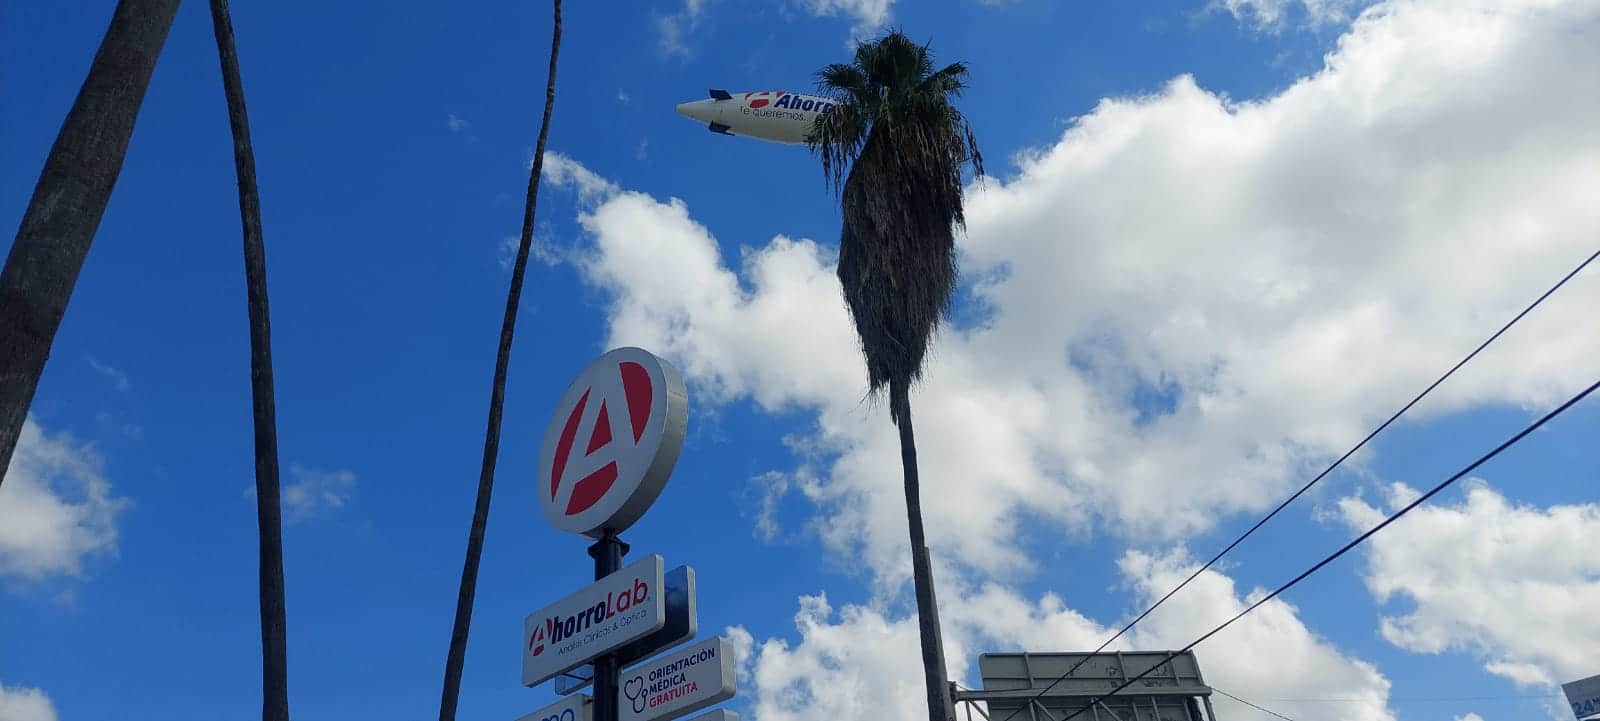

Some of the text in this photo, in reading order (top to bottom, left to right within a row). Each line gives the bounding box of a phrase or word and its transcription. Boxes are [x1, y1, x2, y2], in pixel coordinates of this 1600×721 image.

[773, 94, 834, 114] Ahorr
[648, 647, 715, 682] ORIENTACIÓN
[649, 672, 687, 695] MÉDICA
[649, 681, 698, 708] GRATUITA
